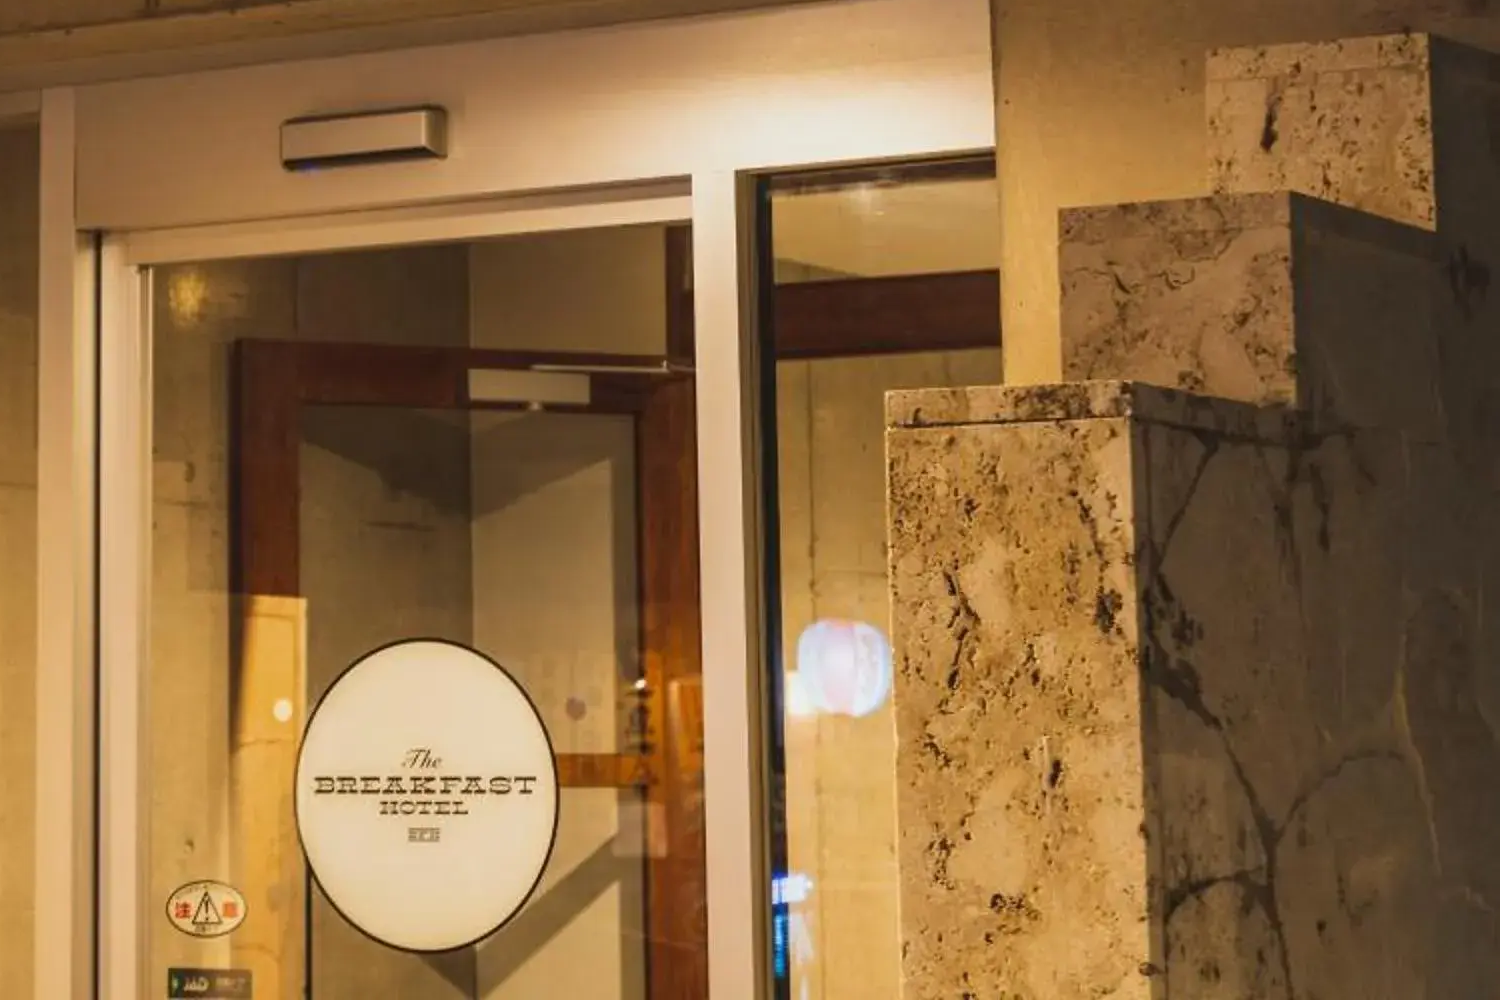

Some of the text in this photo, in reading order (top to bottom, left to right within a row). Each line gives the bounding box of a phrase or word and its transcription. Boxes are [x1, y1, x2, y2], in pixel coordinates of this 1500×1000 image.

[401, 749, 443, 769] The
[313, 776, 537, 795] BREAKFAST
[379, 801, 469, 815] HOTEL
